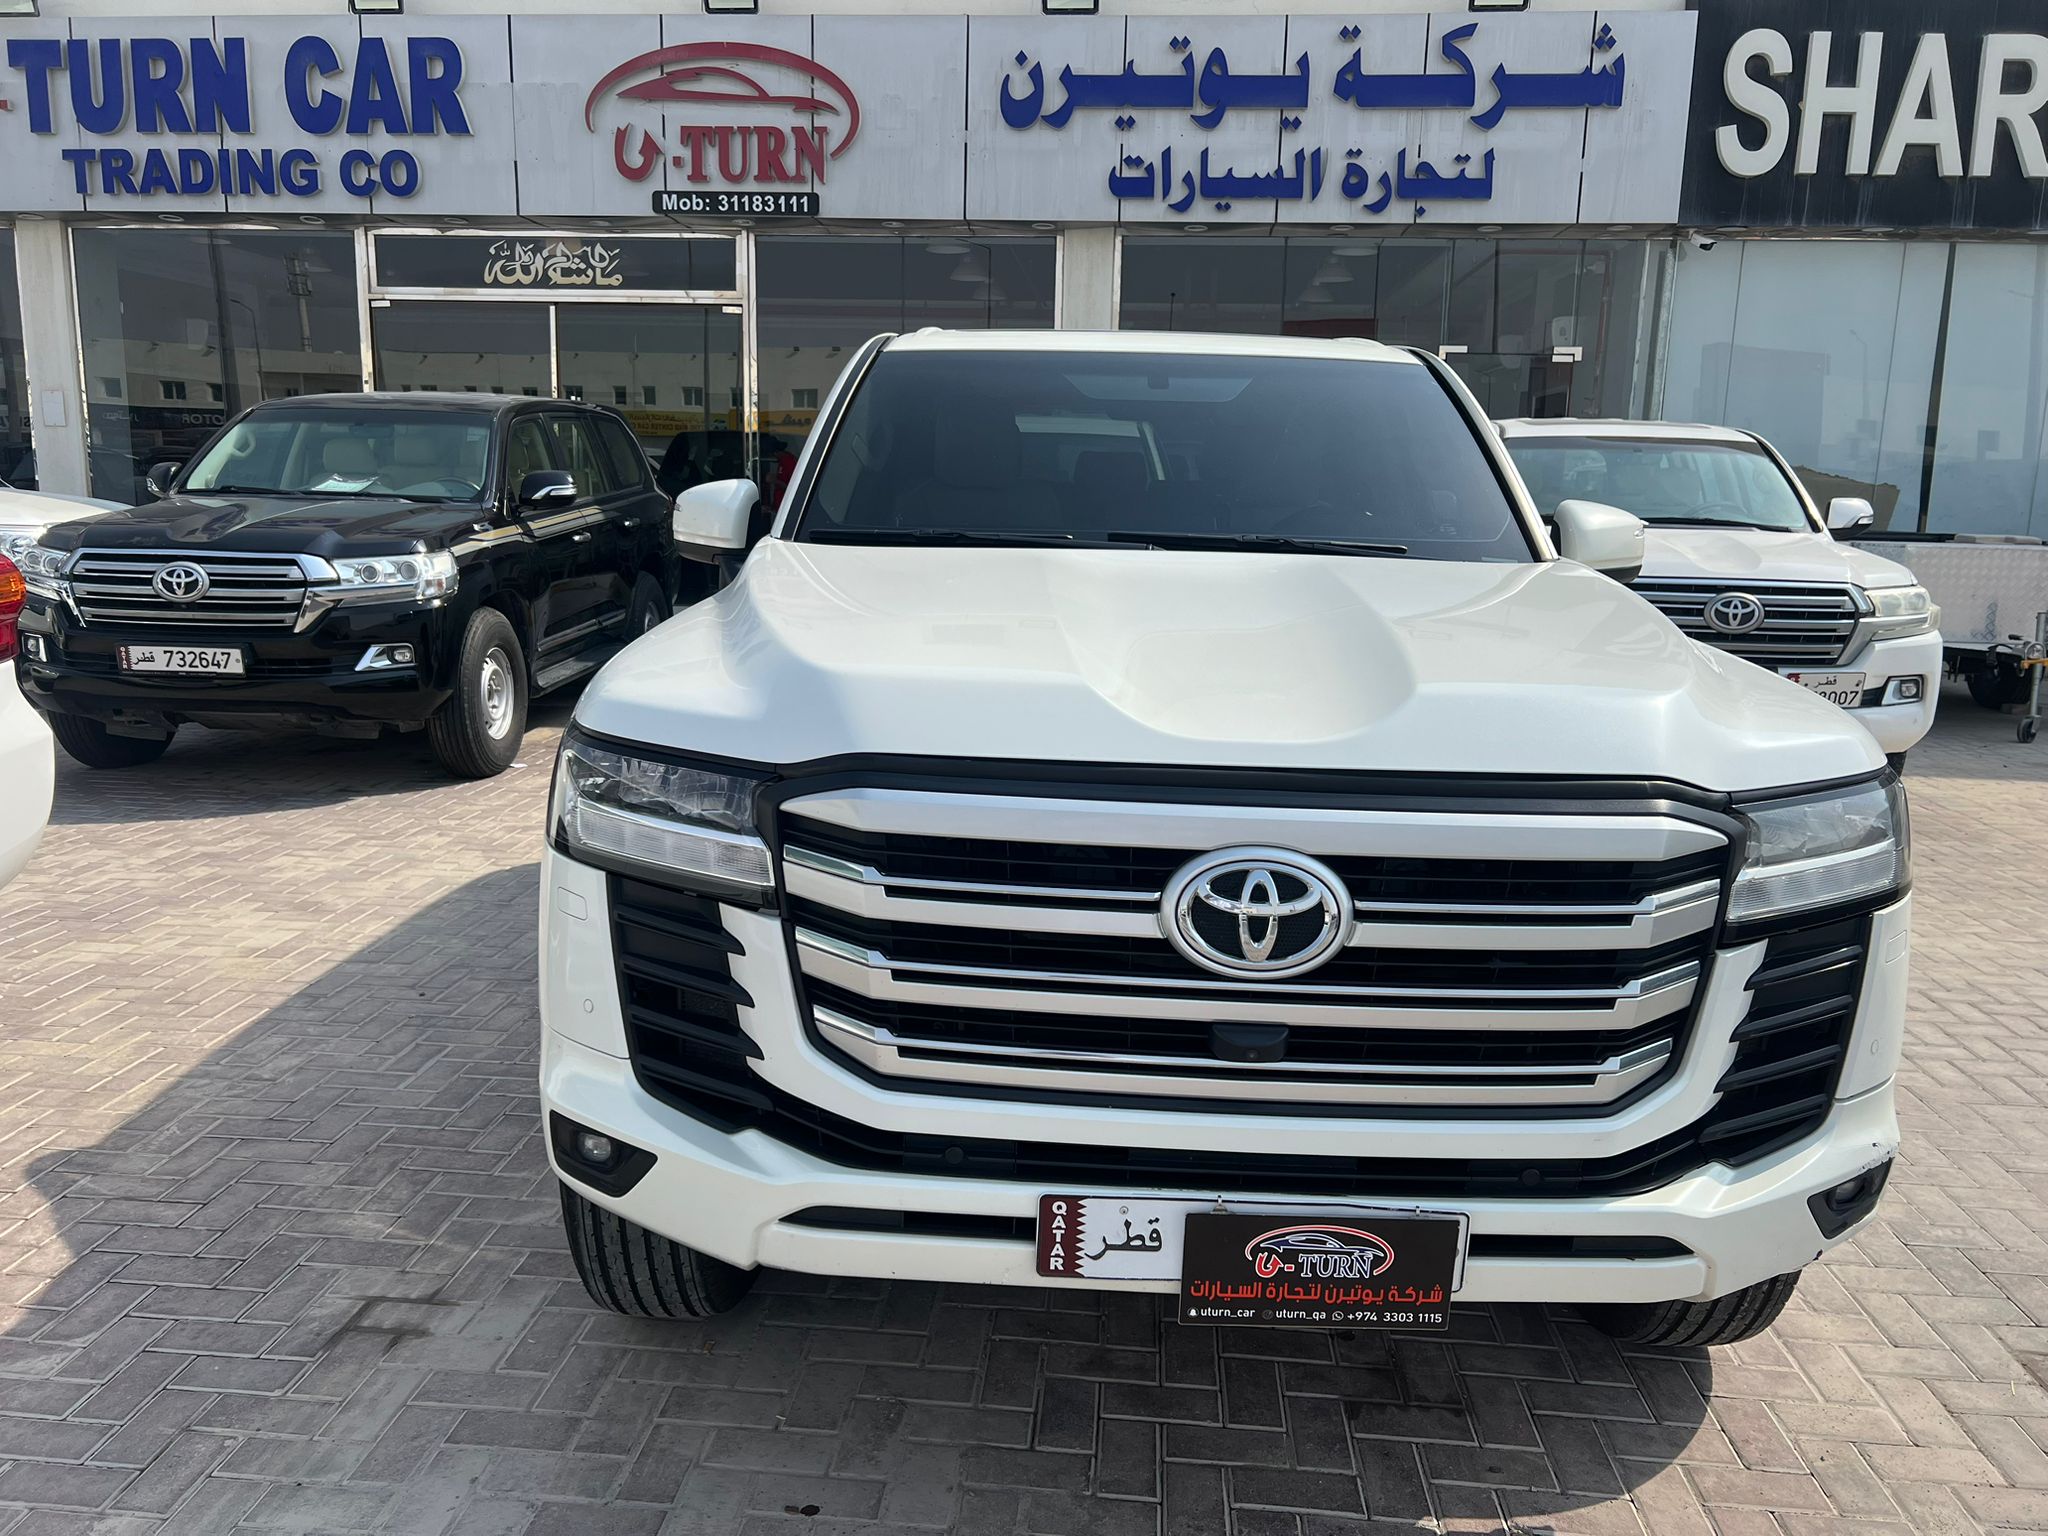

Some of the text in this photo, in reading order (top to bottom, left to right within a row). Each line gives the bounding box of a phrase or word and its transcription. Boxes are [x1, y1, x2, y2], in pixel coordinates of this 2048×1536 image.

[283, 35, 472, 136] CAR
[1000, 23, 1626, 131] شركة يوتيرن
[1715, 28, 2048, 177] SHAR
[62, 147, 422, 198] TRADING CO
[1108, 145, 1496, 217] لتجارة السيارات
[661, 194, 809, 213] Mob: 31183111
[133, 652, 155, 666] قطر
[163, 650, 231, 669] 732647
[1049, 1201, 1066, 1271] QATAR
[1085, 1217, 1162, 1260] قطر
[1190, 1280, 1443, 1306] شركة يوتيرن لتجارة السيارات
[1200, 1307, 1443, 1323] uturn_car uturn_qa +974 3303 1115
